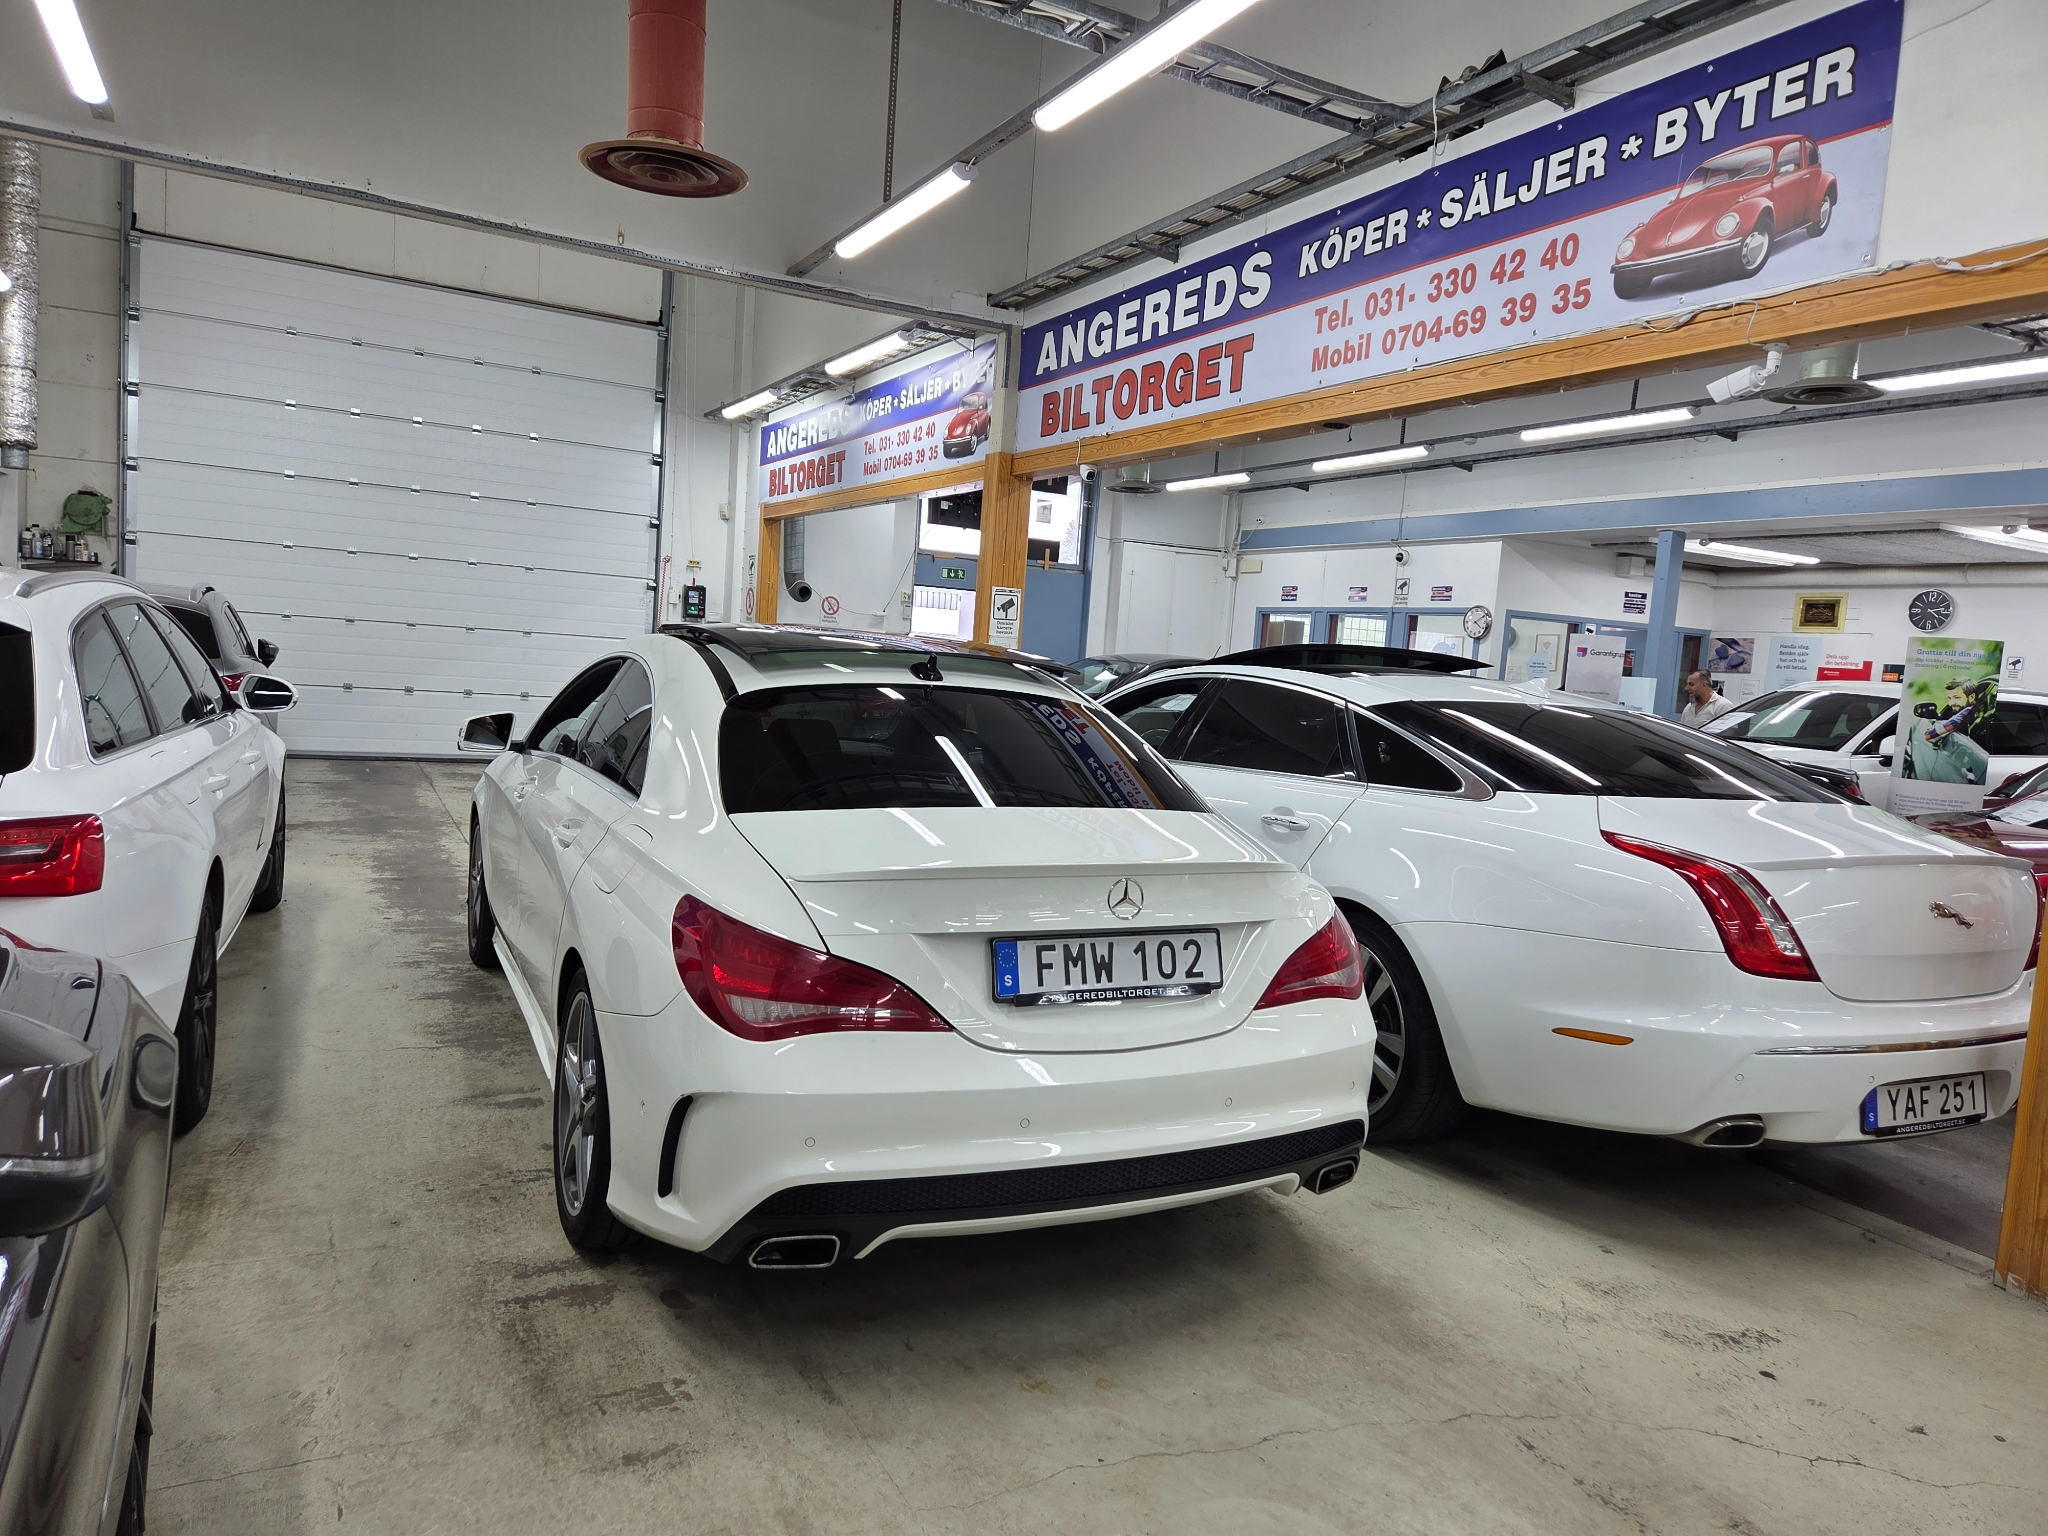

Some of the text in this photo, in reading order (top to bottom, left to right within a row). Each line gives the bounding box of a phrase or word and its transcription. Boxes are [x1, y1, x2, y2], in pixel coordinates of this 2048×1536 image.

[1298, 46, 1857, 279] KÖPER SÄLJER BYTER
[1314, 232, 1580, 334] Tel. 031- 330 42 40
[1035, 250, 1273, 377] ANGEREDS
[1311, 277, 1592, 372] Mobil 0704-69 39 35
[860, 396, 892, 422] KÖPER
[899, 376, 943, 411] SÄLJER
[1040, 333, 1255, 438] BILTORGET
[766, 405, 851, 459] ANGEREDS
[863, 441, 877, 456] Tel.
[896, 431, 910, 449] 330
[913, 425, 923, 442] 42
[925, 421, 936, 438] 40
[768, 450, 846, 498] BILTORGET
[863, 444, 939, 477] Mobil 0704-69 39 35
[1929, 591, 1937, 602] 12
[1916, 648, 1943, 656] Grattis
[1945, 649, 1957, 657] till
[1958, 650, 1971, 658] din
[1004, 939, 1204, 988] S FMW 102
[1868, 1079, 1976, 1122] S YAF 251
